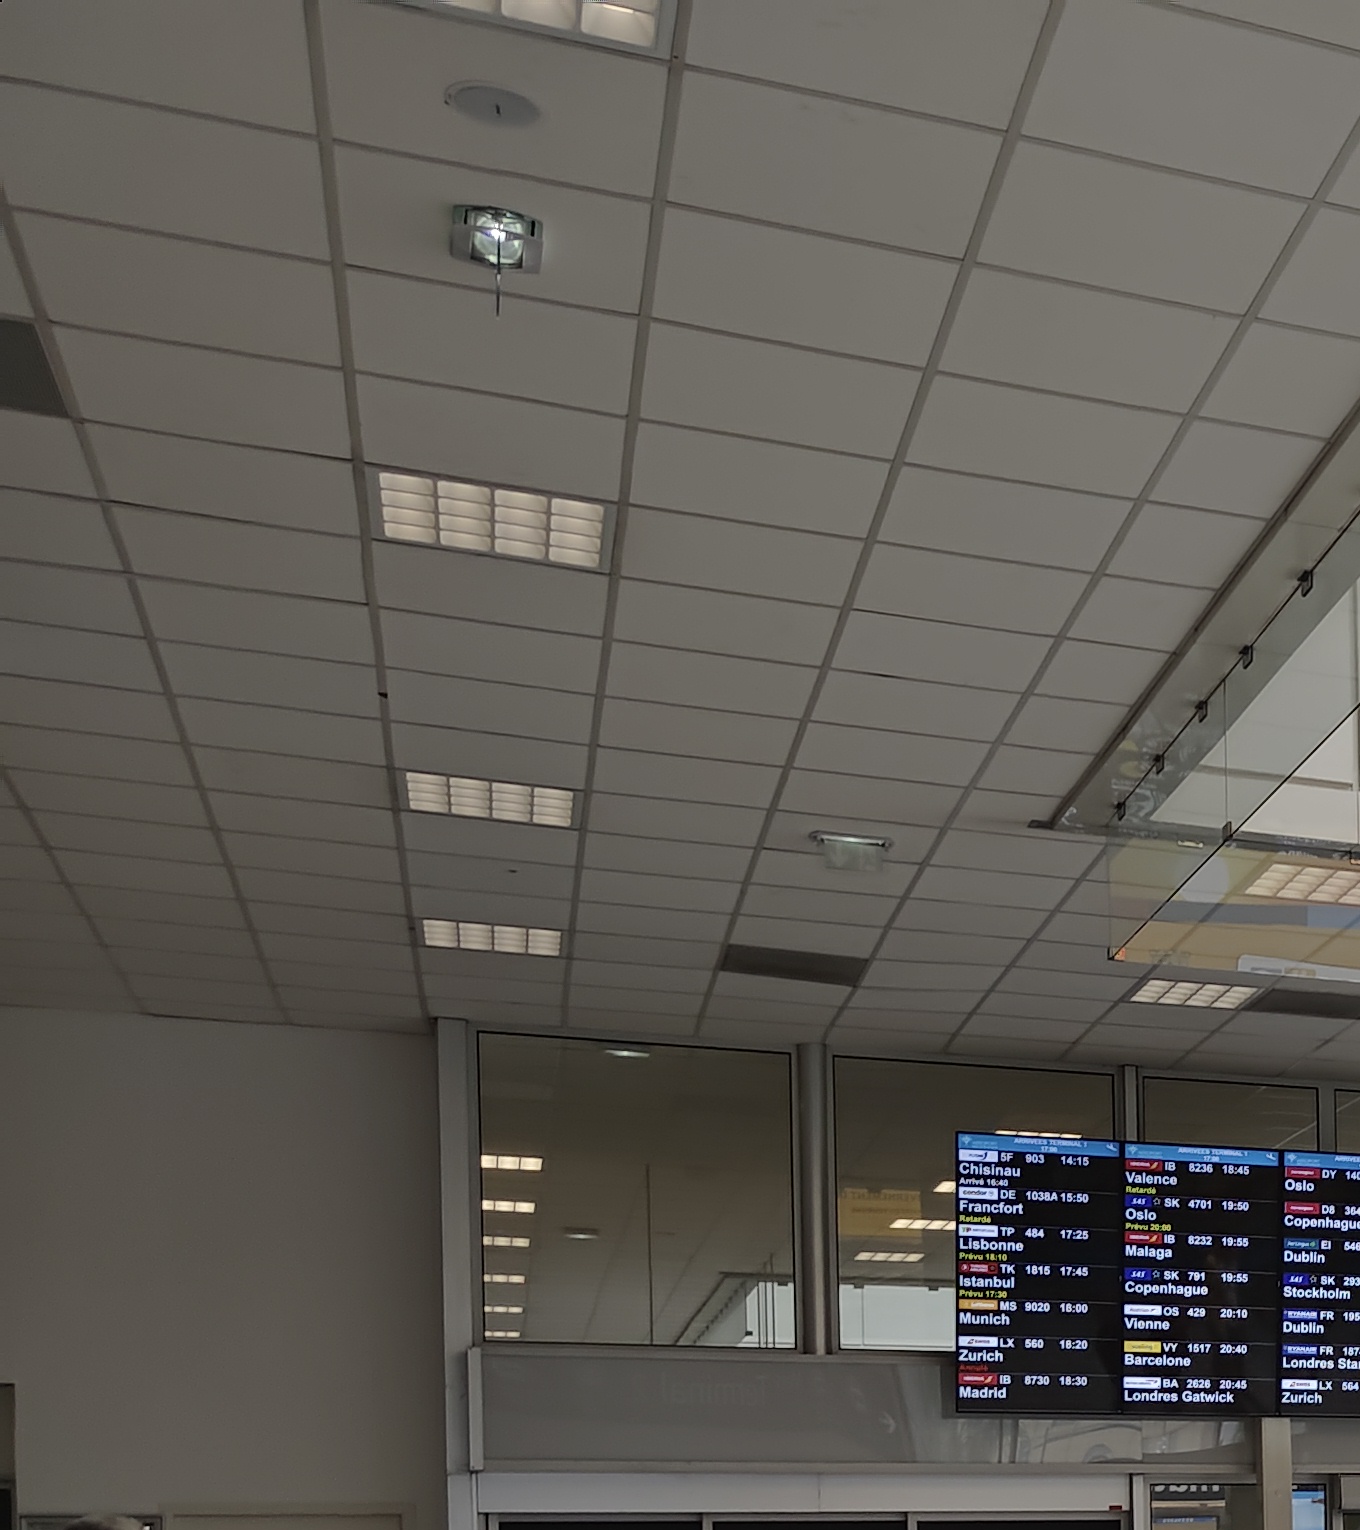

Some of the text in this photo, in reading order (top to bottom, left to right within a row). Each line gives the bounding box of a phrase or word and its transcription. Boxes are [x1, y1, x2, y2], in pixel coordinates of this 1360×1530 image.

[1026, 1155, 1044, 1163] 903
[1061, 1156, 1089, 1166] 14:15
[959, 1163, 1020, 1177] Chisinau
[1165, 1162, 1249, 1175] IB 8236 18:45
[1126, 1172, 1177, 1185] Valence
[1322, 1170, 1337, 1179] DY
[1285, 1180, 1314, 1191] Oslo
[1000, 1190, 1016, 1199] DE
[1061, 1193, 1089, 1203] 15:50
[960, 1201, 1023, 1214] Francfort
[1165, 1199, 1249, 1211] SK 4701 19:50
[1126, 1209, 1156, 1220] Oslo
[1001, 1228, 1014, 1236] TP
[1025, 1229, 1044, 1238] 484
[1060, 1230, 1089, 1239] 17:25
[959, 1239, 1023, 1251] Lisbonne
[1164, 1235, 1248, 1247] IB 8232 19:55
[1125, 1246, 1172, 1260] Malaga
[1284, 1251, 1325, 1263] Dublin
[1001, 1265, 1088, 1277] TK 1815 17:45
[1164, 1271, 1248, 1282] SK 791 19:55
[959, 1276, 1014, 1288] Istanbul
[1321, 1276, 1335, 1285] SK
[1125, 1282, 1208, 1297] Copenhague
[1283, 1287, 1350, 1299] Stockholm
[1000, 1301, 1017, 1311] MS
[1025, 1303, 1050, 1312] 9020
[1164, 1307, 1247, 1318] OS 429 20:10
[1320, 1311, 1334, 1320] FR
[959, 1312, 1010, 1325] Munich
[1125, 1318, 1170, 1330] Vienne
[1283, 1322, 1324, 1333] Dublin
[1000, 1339, 1014, 1347] LX
[1025, 1339, 1044, 1348] 560
[1060, 1340, 1088, 1349] 18:20
[1164, 1343, 1247, 1354] VY 1517 20:40
[959, 1350, 1003, 1361] Zurich
[1320, 1347, 1333, 1355] FR
[1124, 1355, 1191, 1366] Barcelone
[1283, 1358, 1334, 1369] Londres
[1000, 1375, 1011, 1384] IB
[1059, 1377, 1087, 1386] 18:30
[1163, 1379, 1179, 1388] BA
[1219, 1380, 1247, 1389] 20:45
[1319, 1381, 1332, 1390] LX
[959, 1387, 1006, 1398] Madrid
[1124, 1390, 1234, 1403] Londres Gatwick
[1281, 1392, 1322, 1403] Zurich
